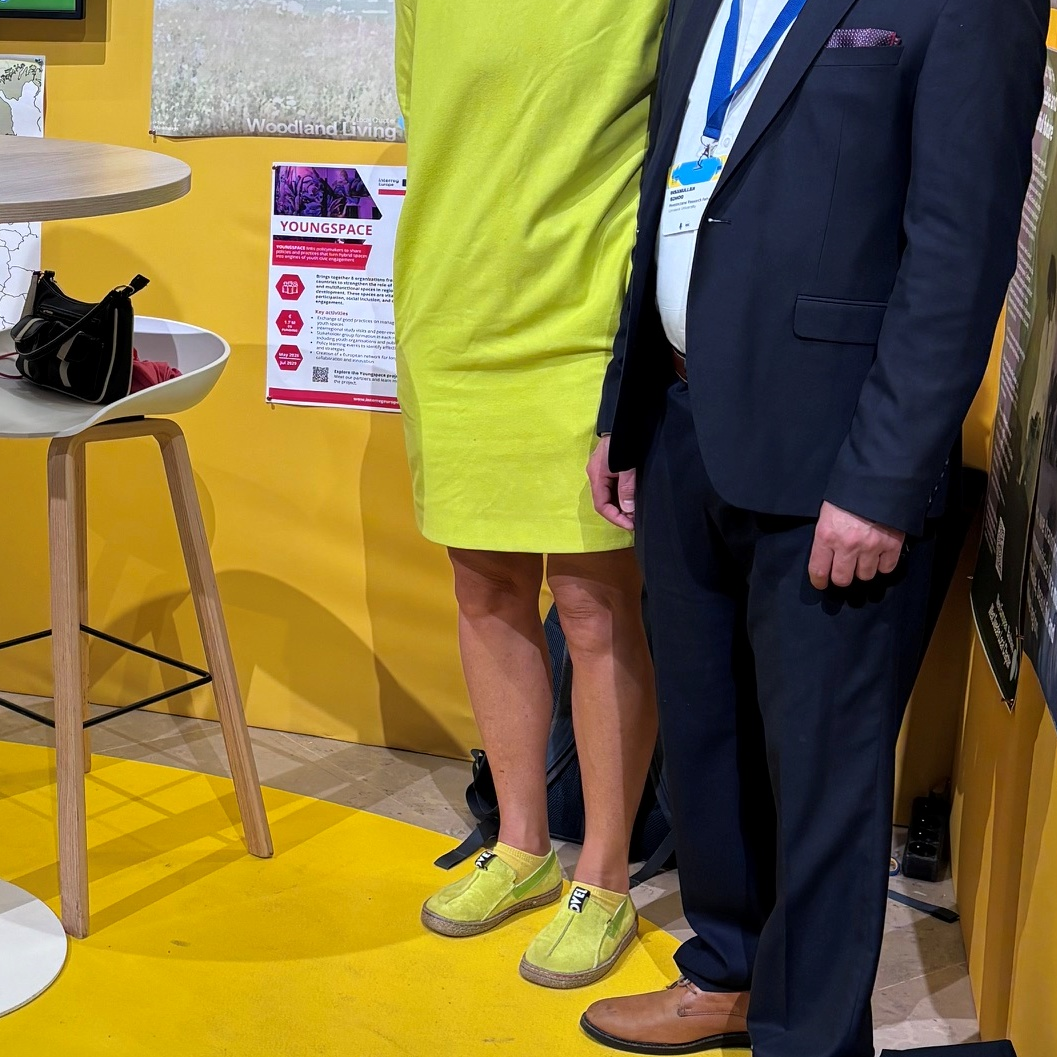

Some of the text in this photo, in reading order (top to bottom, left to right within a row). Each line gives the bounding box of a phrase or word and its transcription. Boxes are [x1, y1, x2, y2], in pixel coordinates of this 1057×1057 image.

[247, 117, 338, 137] Woodland
[343, 121, 397, 140] Living
[280, 220, 373, 236] YOUNGSPACE
[276, 244, 306, 252] YOUNGSPACE
